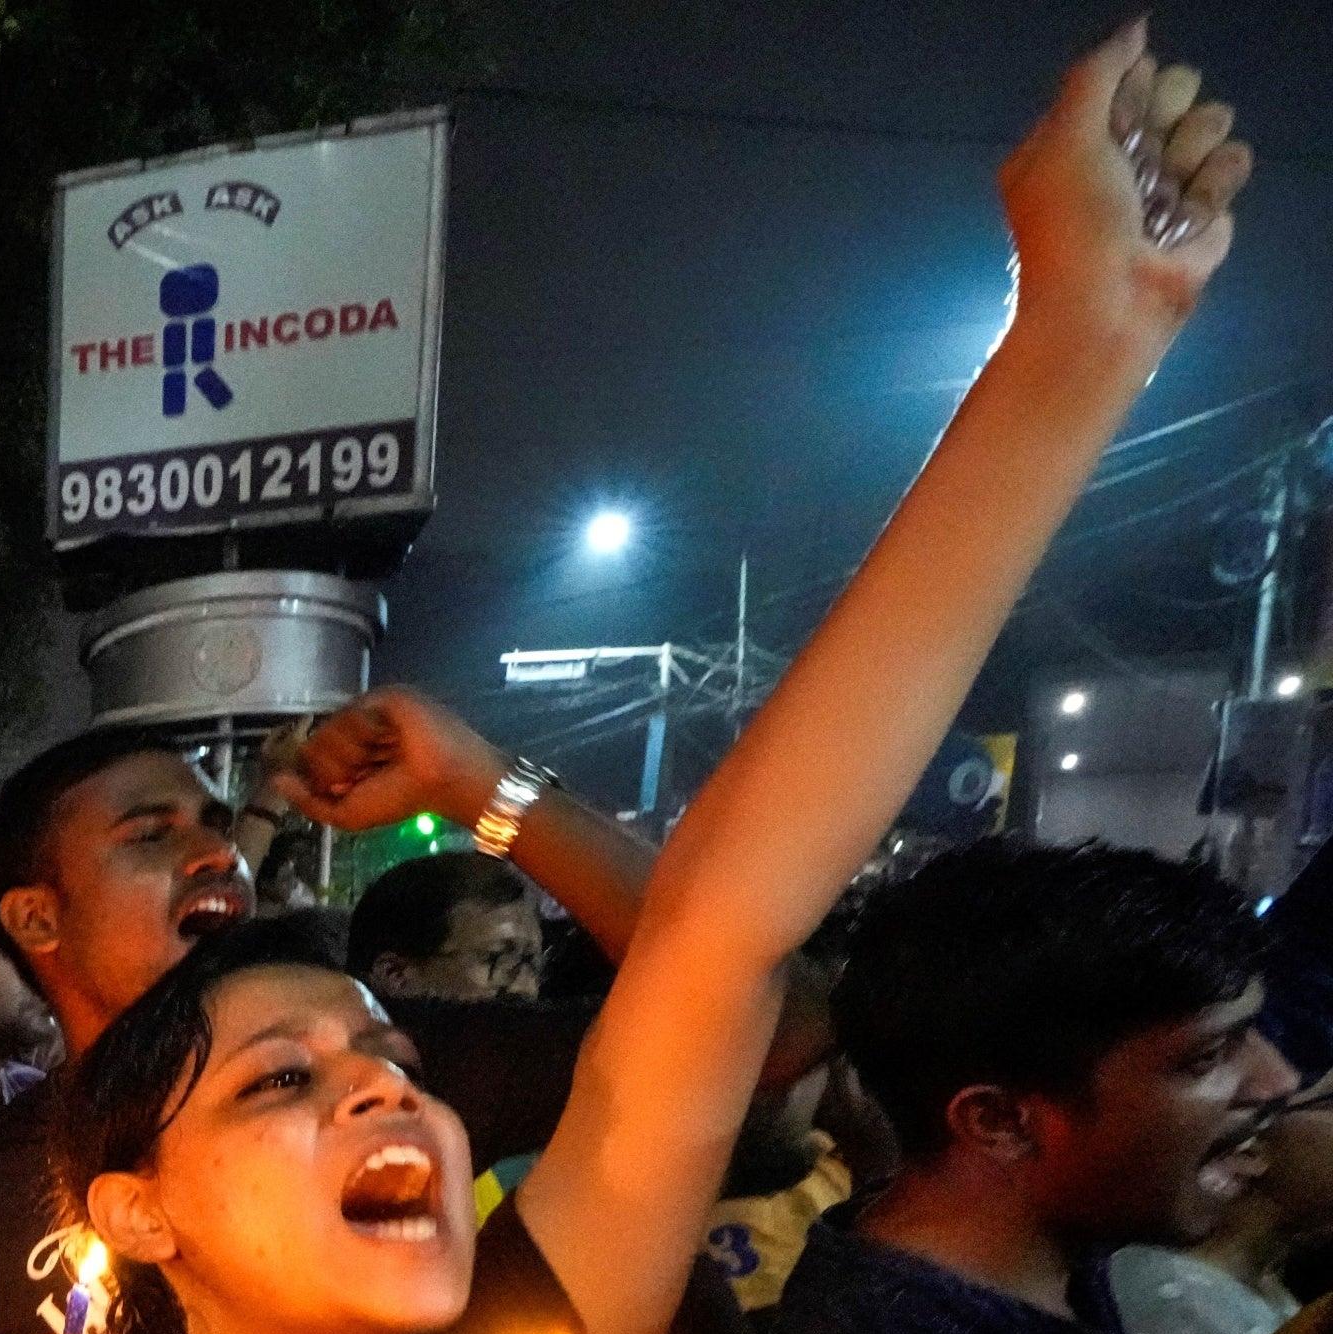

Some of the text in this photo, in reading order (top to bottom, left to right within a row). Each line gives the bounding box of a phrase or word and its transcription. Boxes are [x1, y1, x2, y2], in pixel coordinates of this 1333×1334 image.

[111, 184, 278, 245] ASK ASK
[71, 333, 155, 374] THE
[224, 298, 399, 353] INCODA
[61, 432, 400, 524] 9830012199
